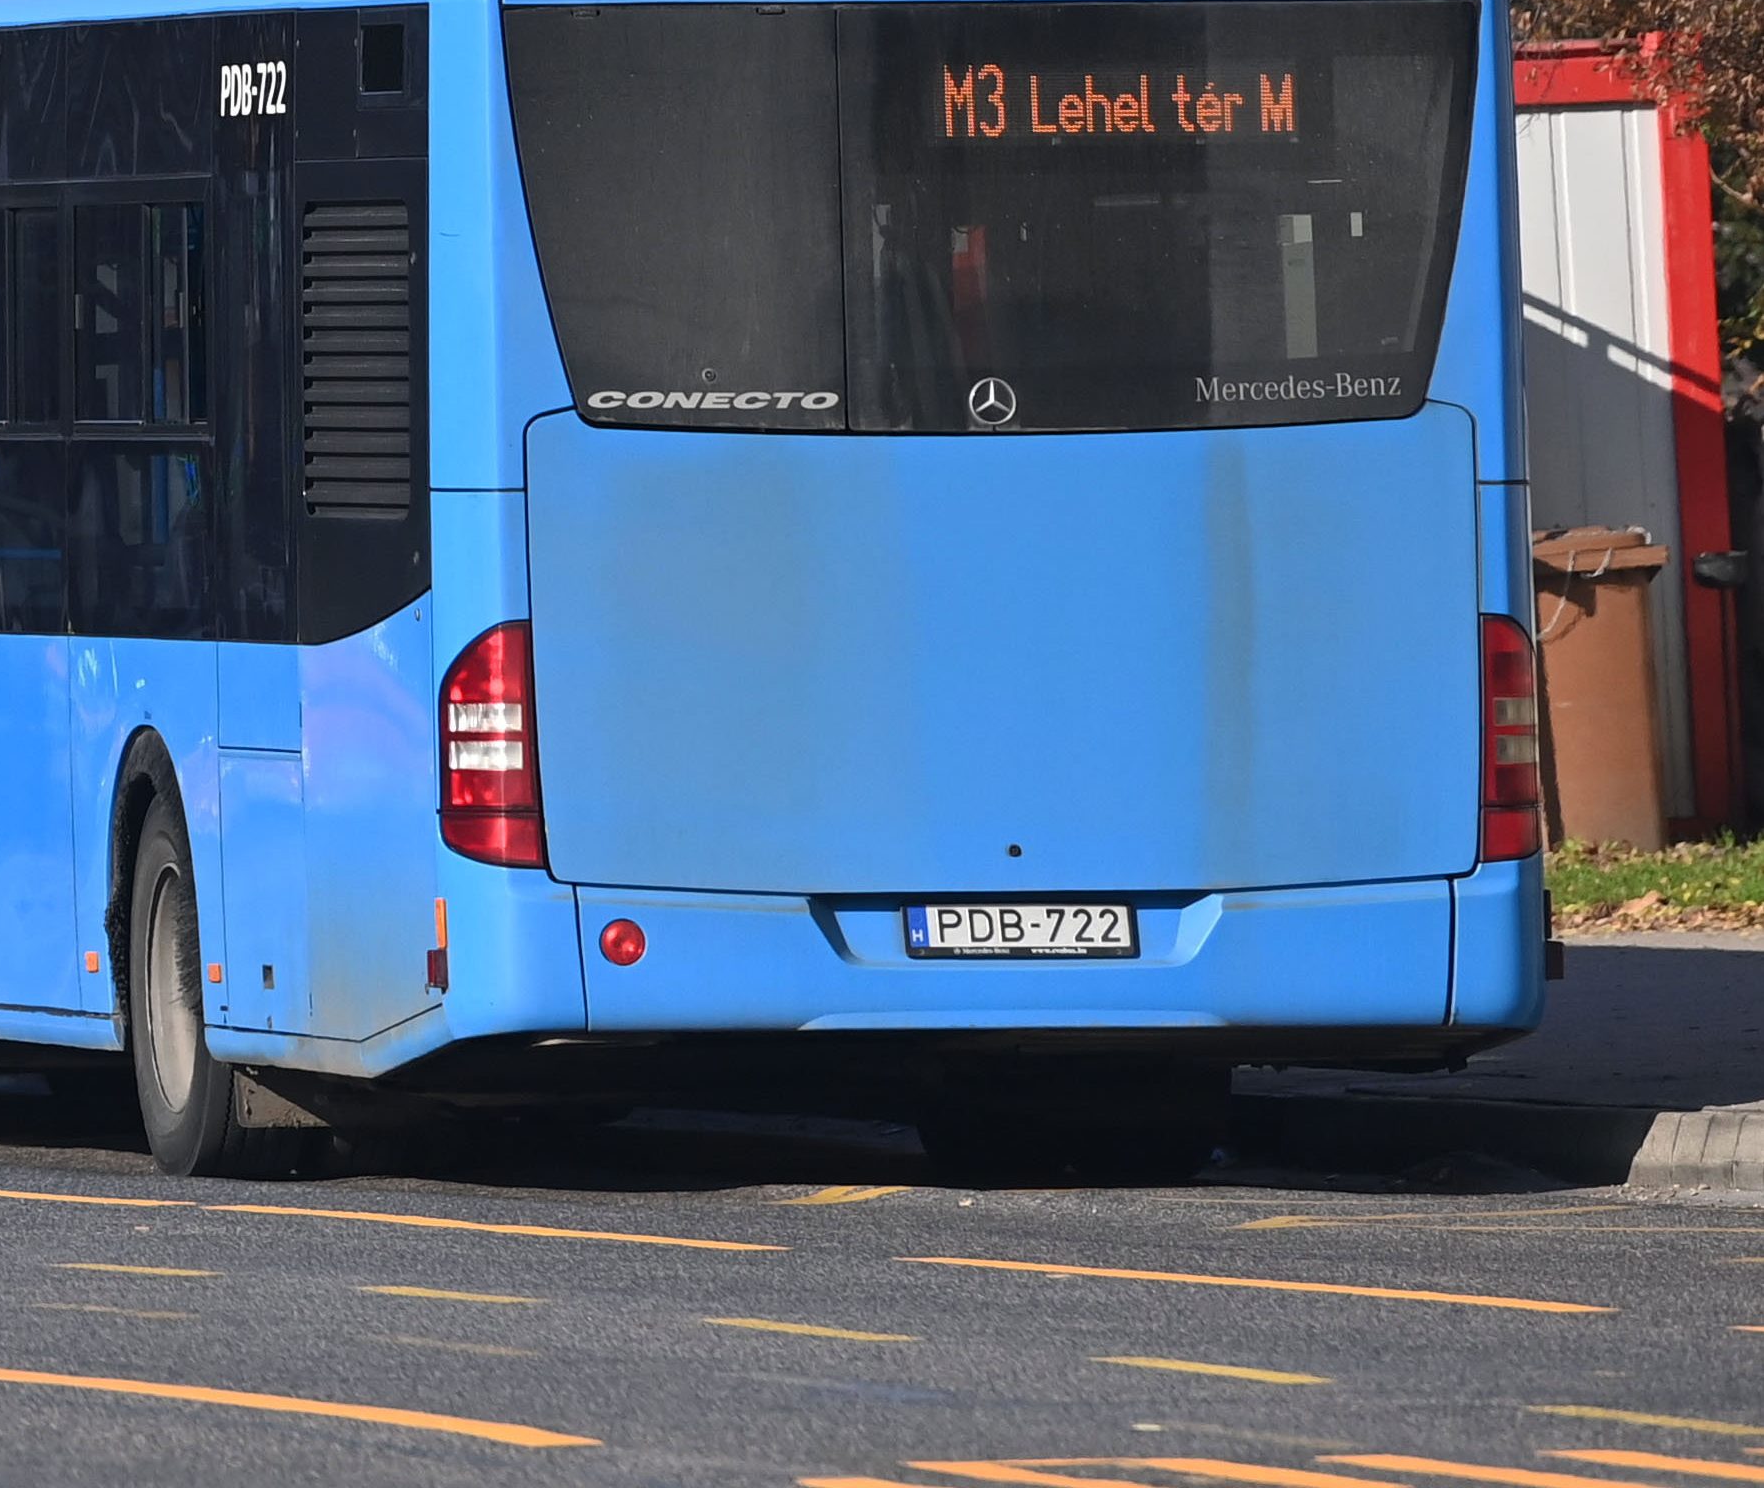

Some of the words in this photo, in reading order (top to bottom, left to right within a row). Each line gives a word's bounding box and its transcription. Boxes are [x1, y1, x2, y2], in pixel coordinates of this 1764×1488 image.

[220, 60, 287, 118] PDB-722
[943, 63, 1007, 137] M3
[1029, 73, 1156, 133] Lehel
[1171, 73, 1244, 132] tér
[1259, 73, 1295, 132] M
[587, 390, 840, 410] CONECTO
[1195, 372, 1402, 402] Mercedes-Benz
[936, 908, 1121, 944] PDB-722
